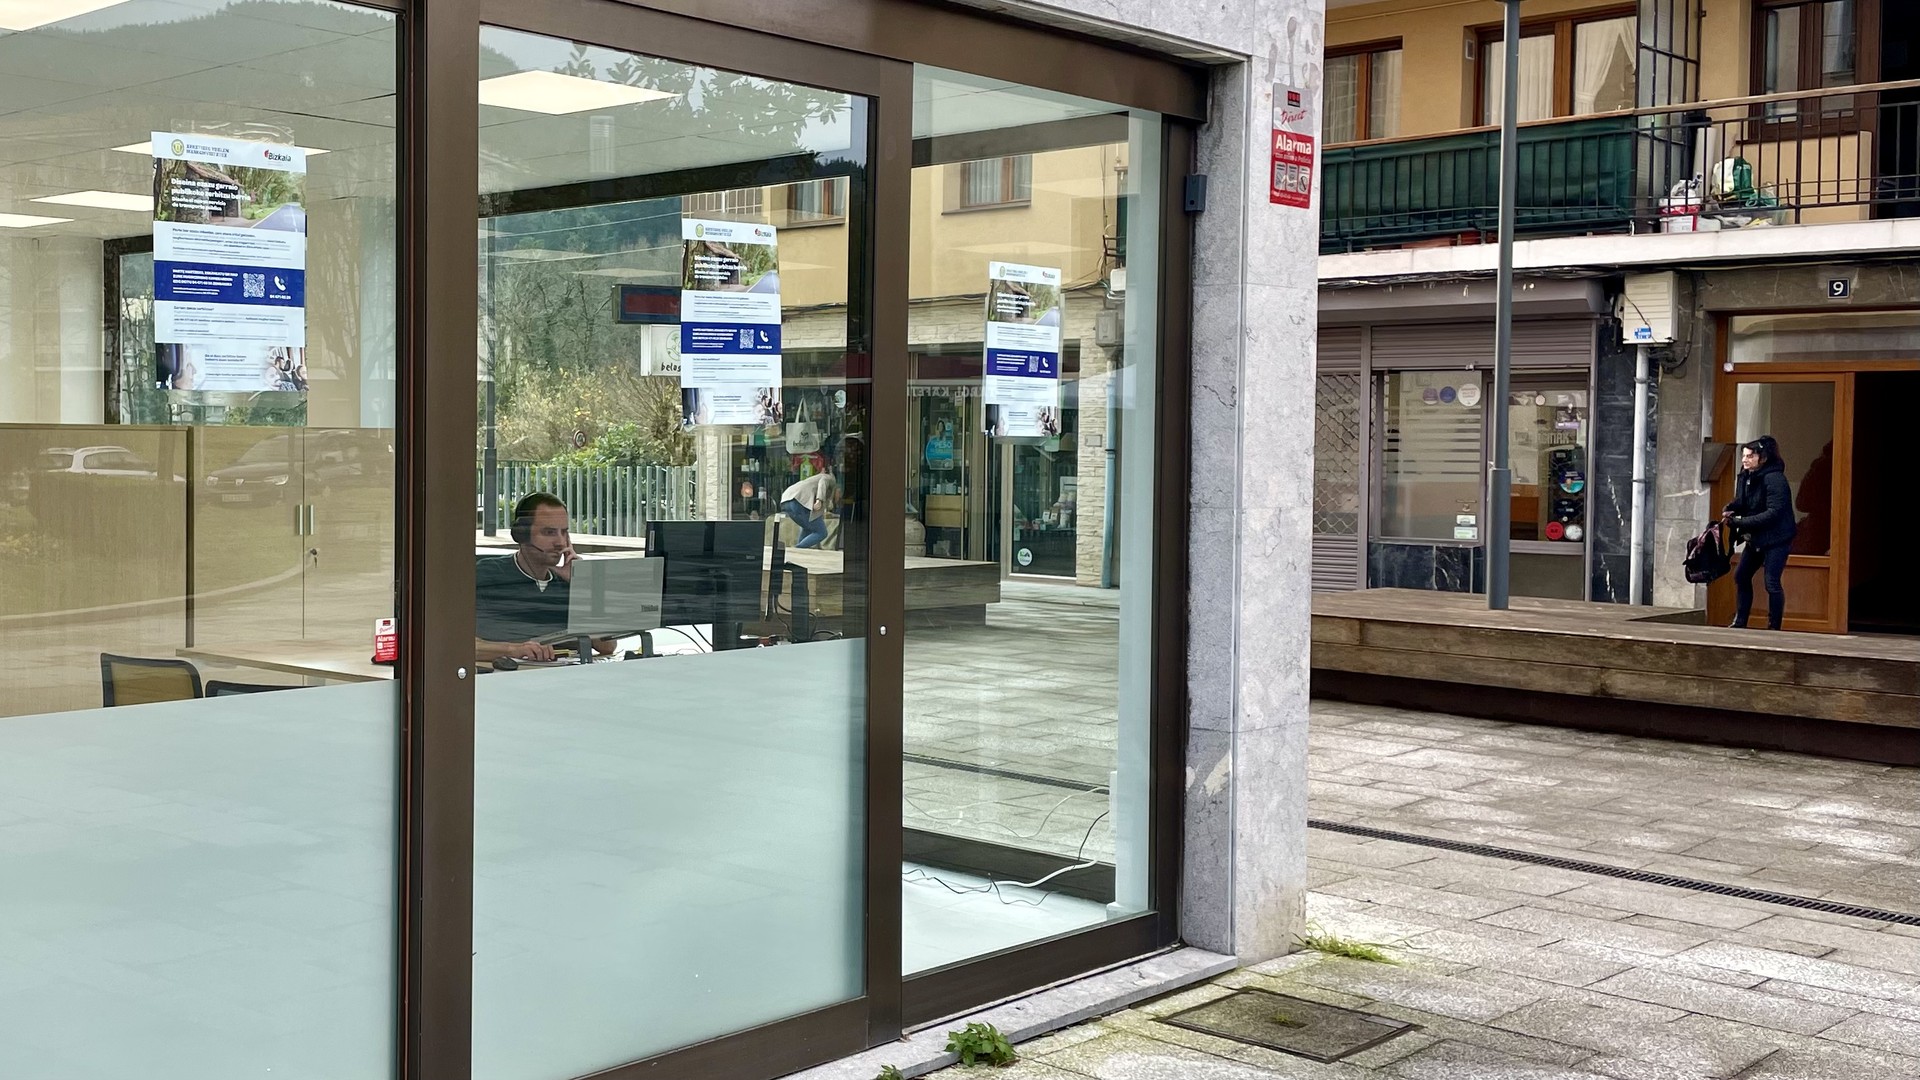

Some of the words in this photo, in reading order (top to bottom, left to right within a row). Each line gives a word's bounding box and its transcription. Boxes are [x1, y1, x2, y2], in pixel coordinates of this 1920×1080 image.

[1275, 134, 1312, 155] Alarma
[268, 152, 292, 162] Bizkaia
[215, 183, 239, 191] garraio
[205, 191, 231, 199] zerbitzu
[1833, 281, 1844, 296] 9
